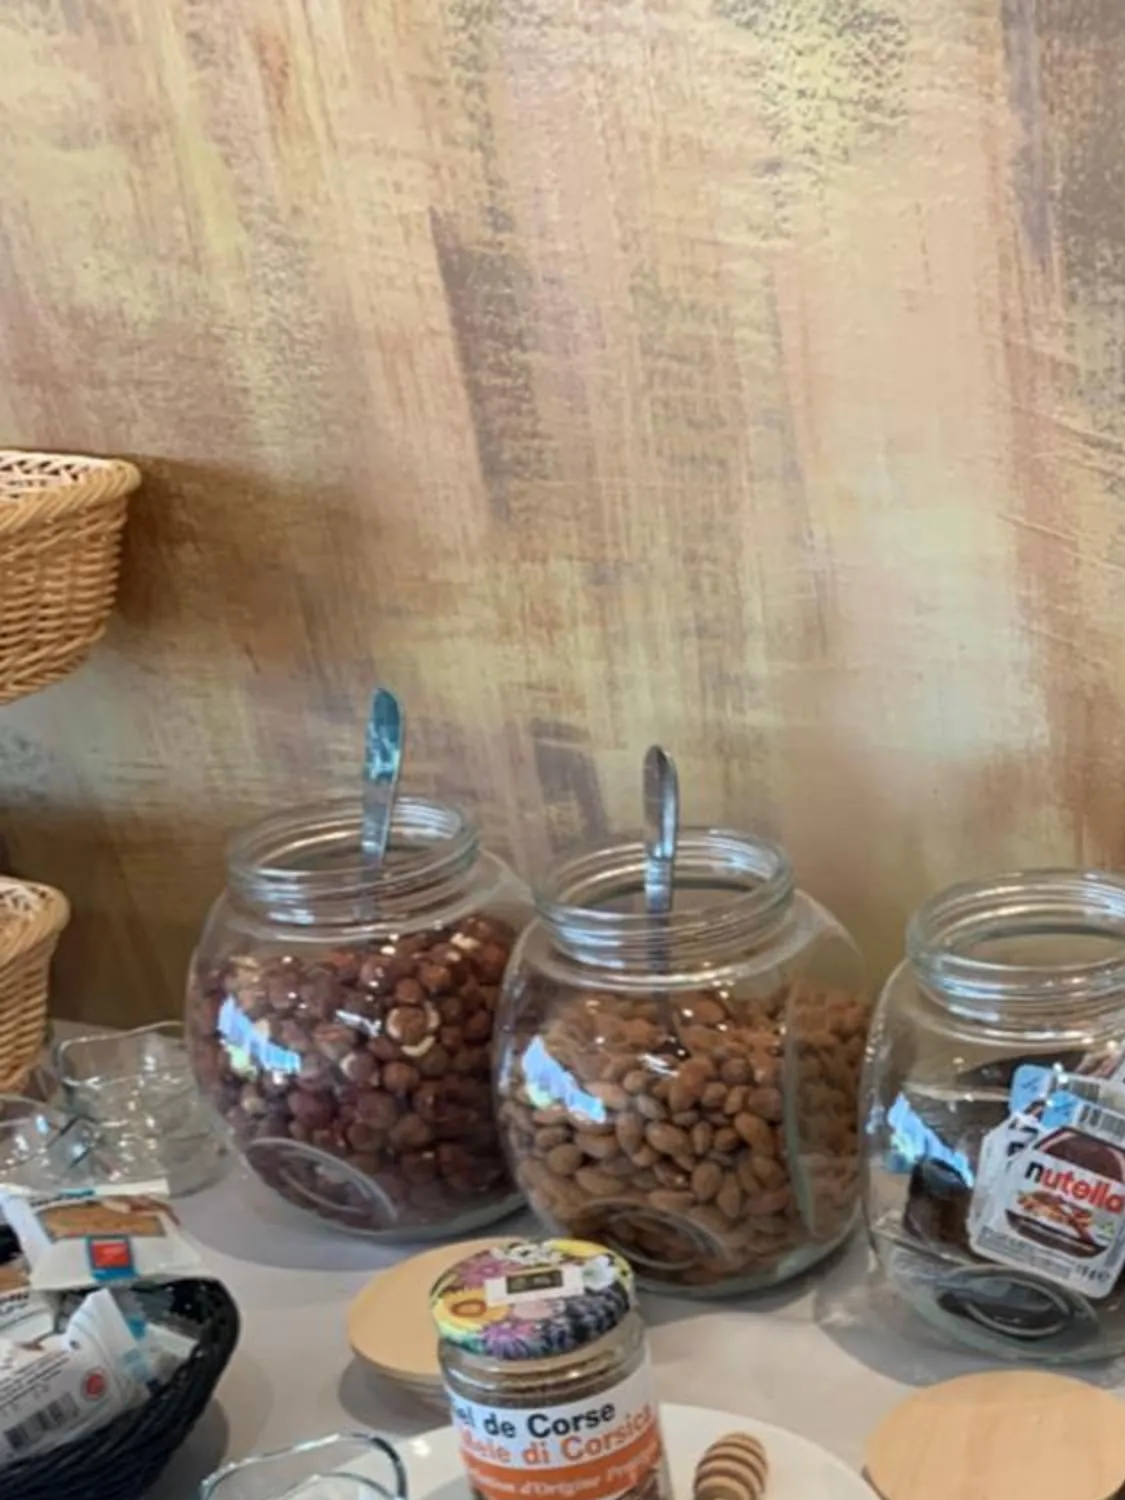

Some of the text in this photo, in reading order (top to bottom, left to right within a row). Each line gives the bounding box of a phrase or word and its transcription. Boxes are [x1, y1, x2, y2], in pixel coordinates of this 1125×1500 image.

[483, 1412, 517, 1439] de
[526, 1402, 615, 1439] Corse
[522, 1440, 551, 1465] di
